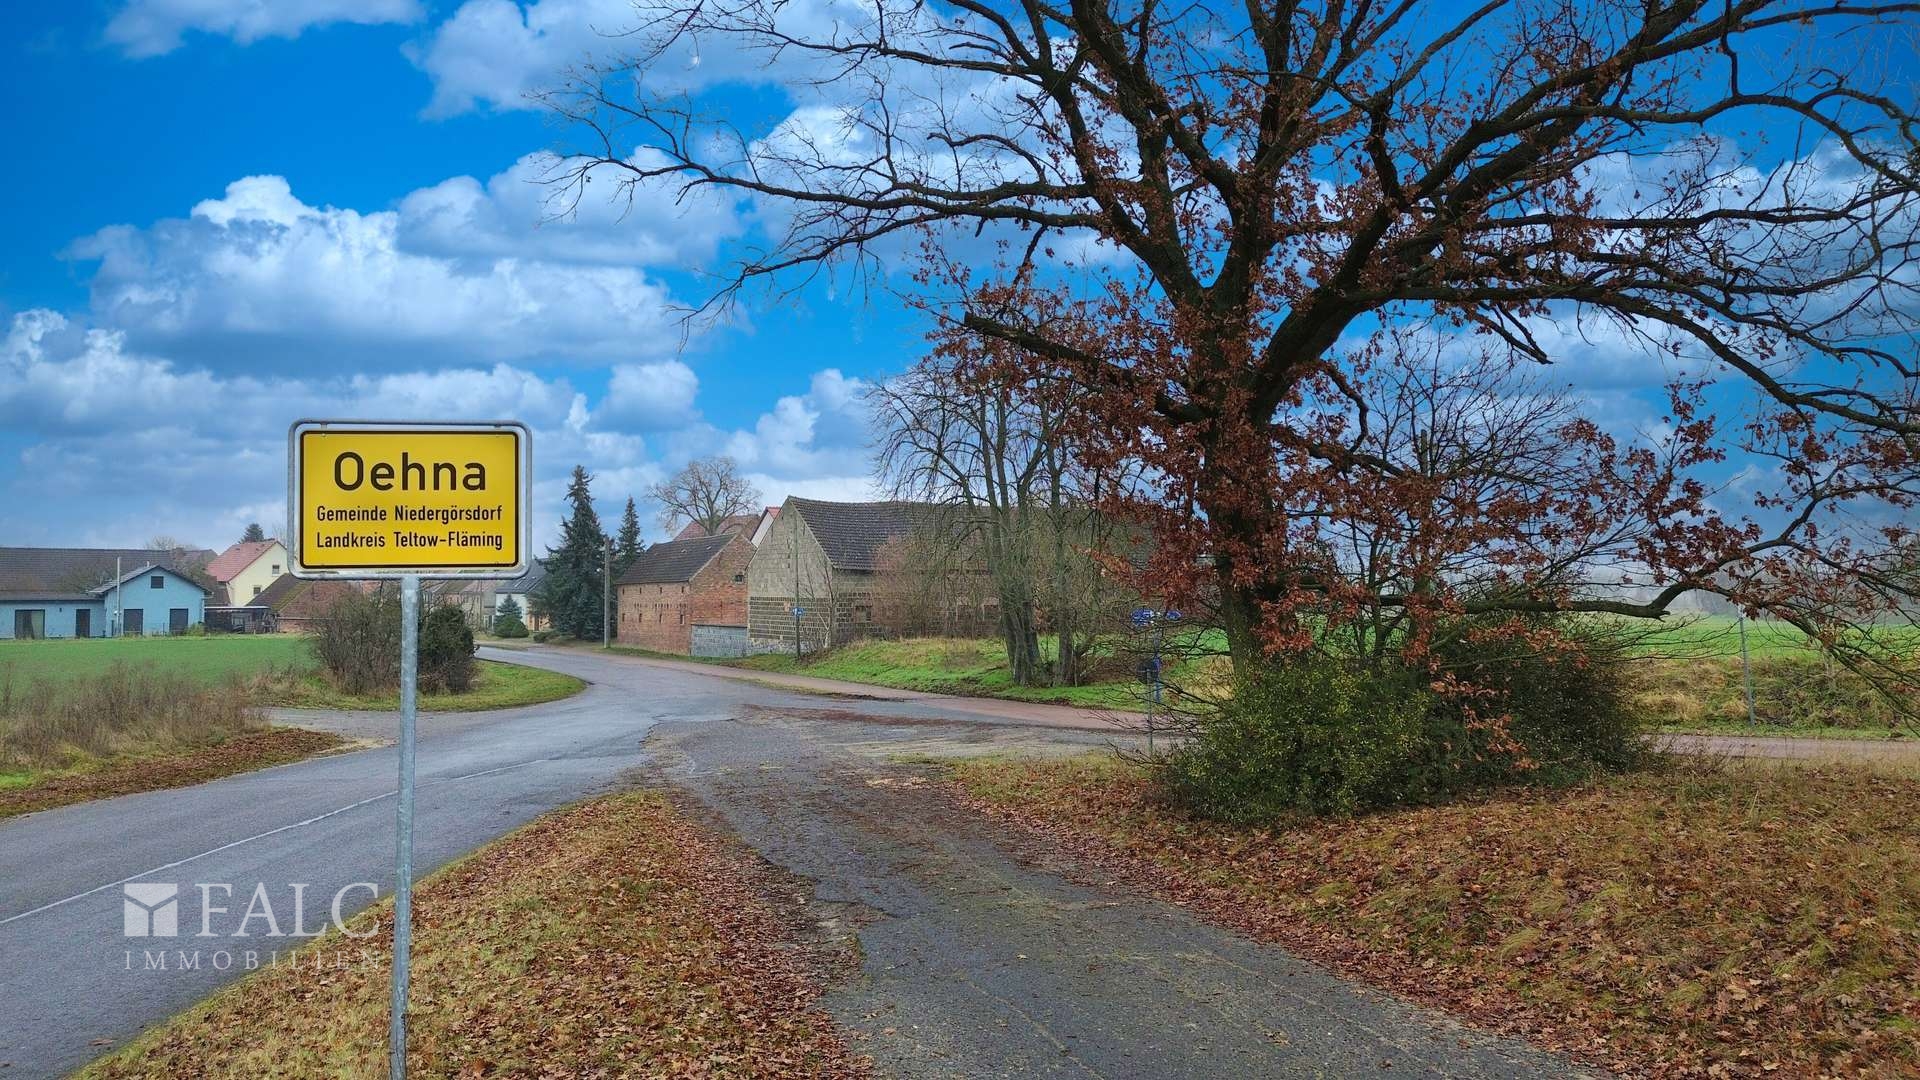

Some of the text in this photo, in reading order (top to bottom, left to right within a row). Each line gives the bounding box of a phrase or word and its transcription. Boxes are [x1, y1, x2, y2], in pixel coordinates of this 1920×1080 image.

[334, 451, 486, 491] Oehna
[317, 504, 502, 525] Gemeinde Niedergörsdorf
[317, 531, 503, 550] Landkreis Teltow-Fläming
